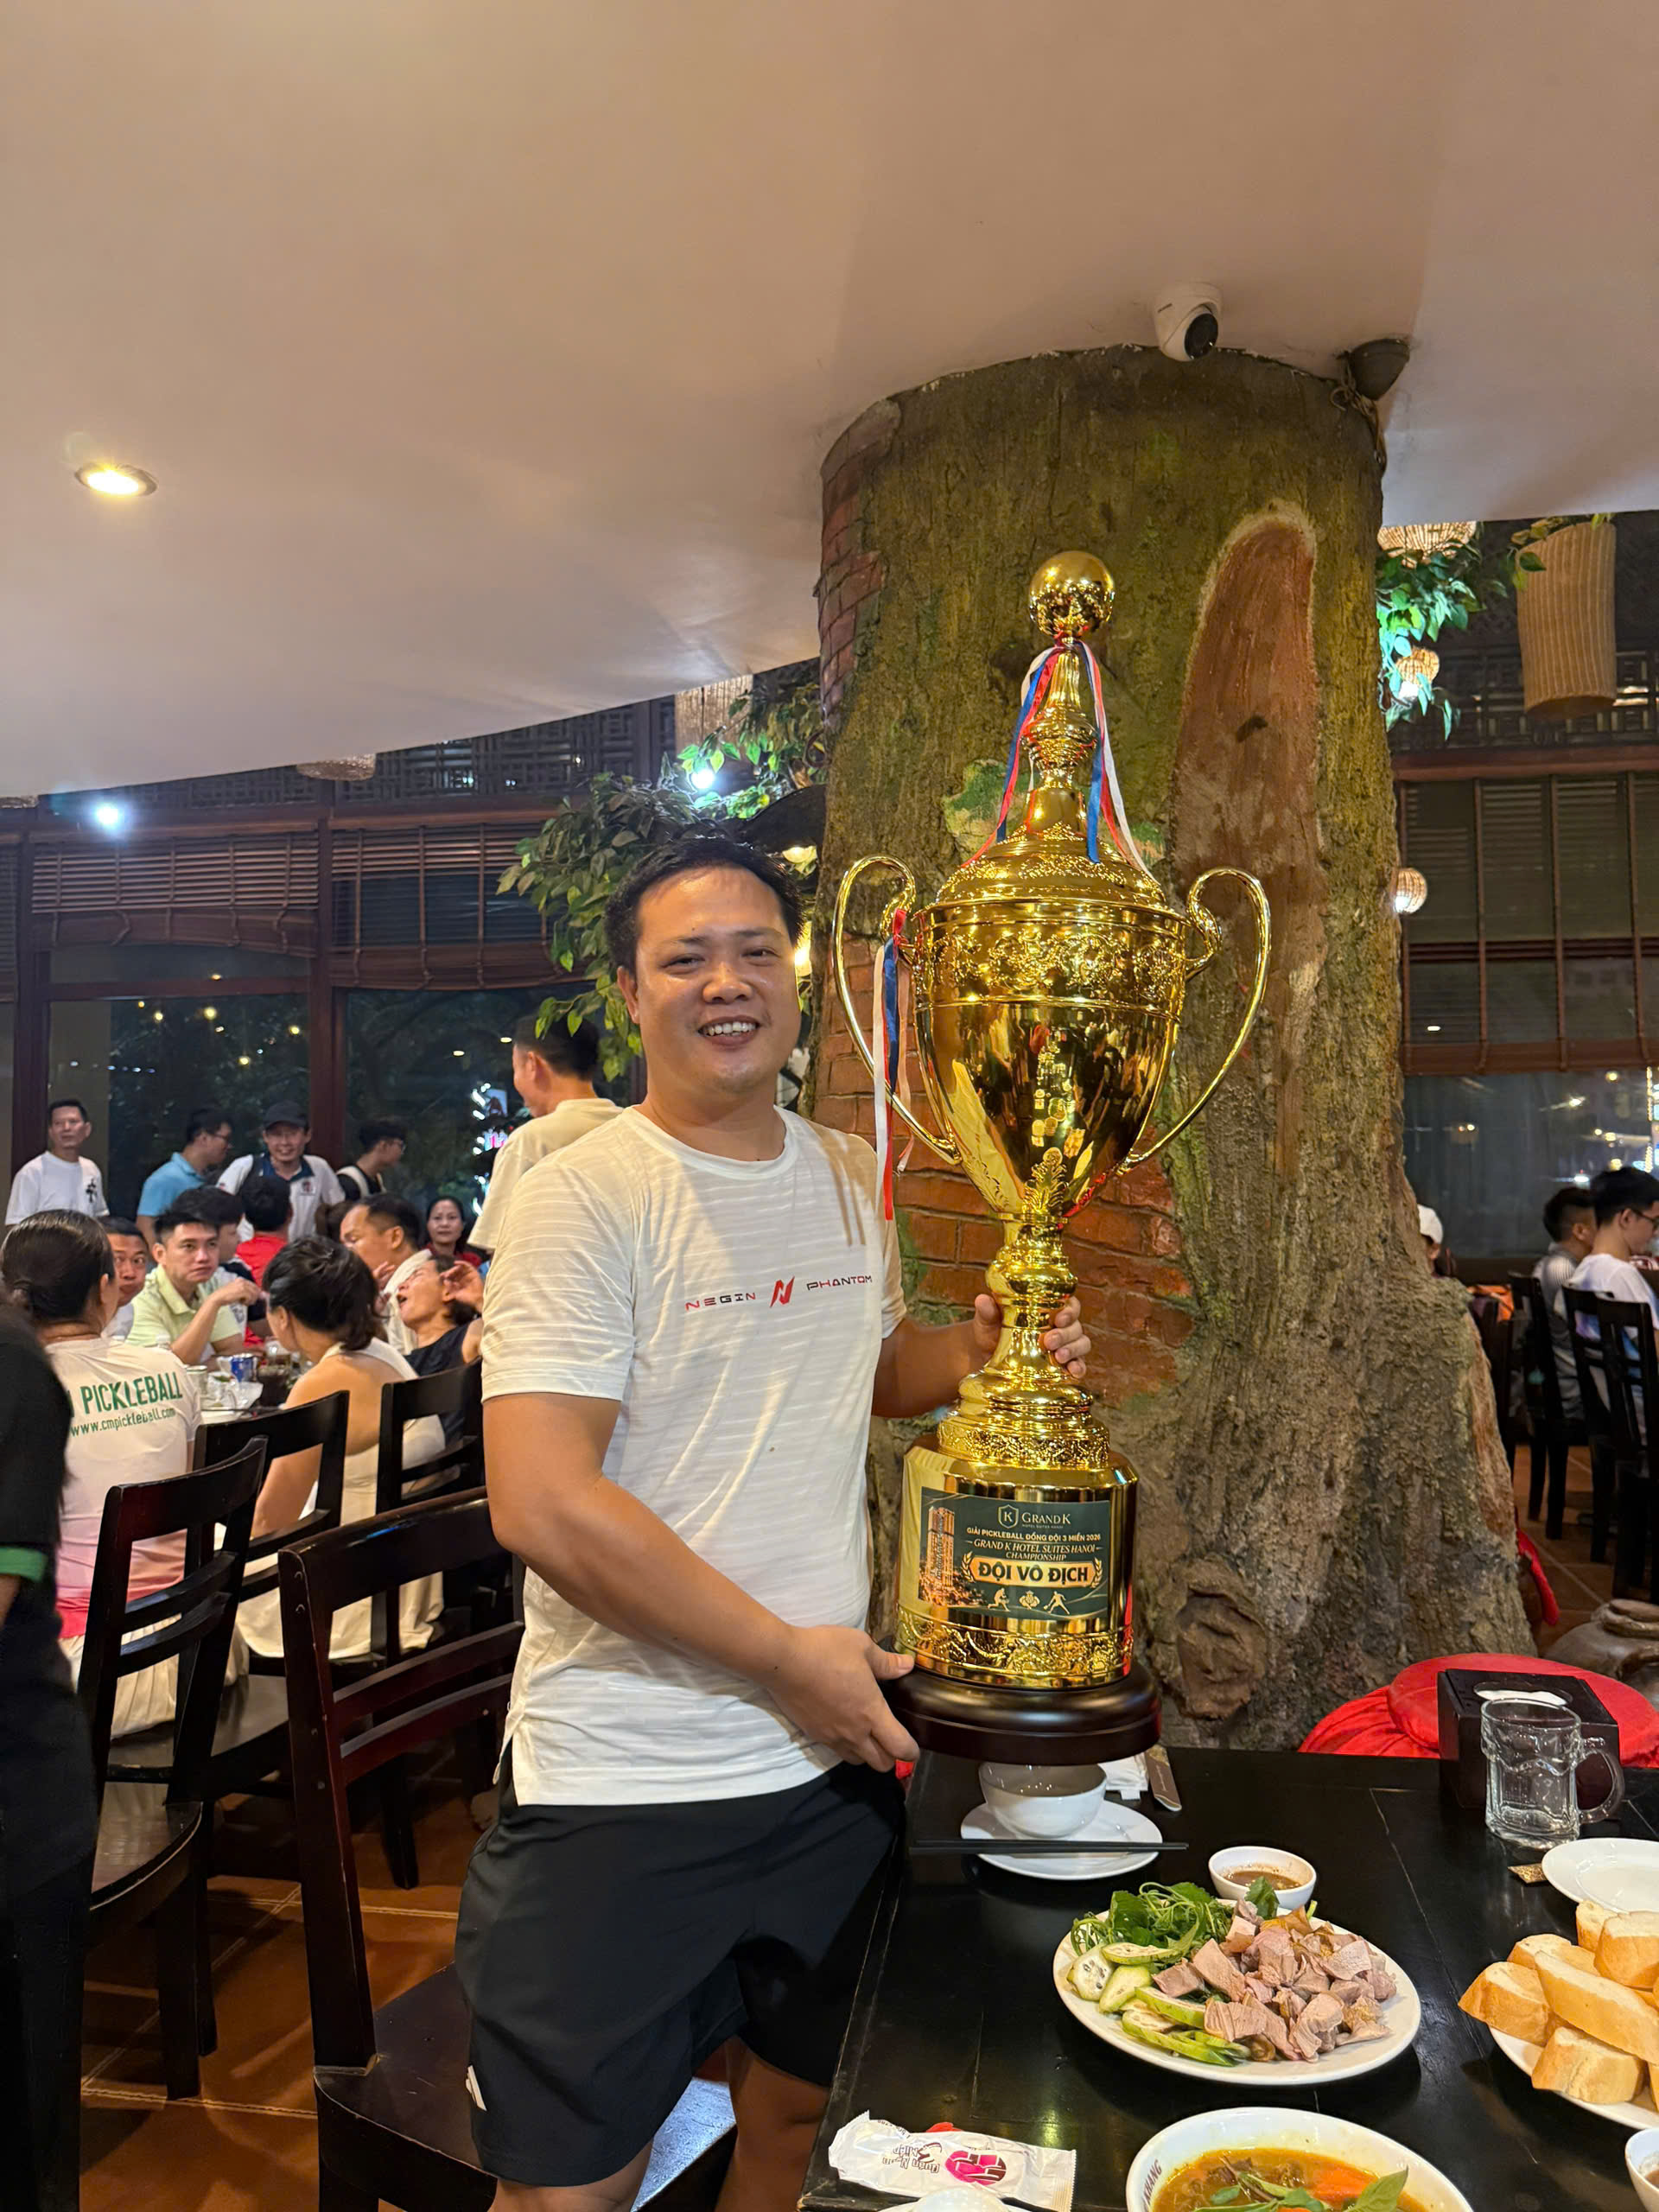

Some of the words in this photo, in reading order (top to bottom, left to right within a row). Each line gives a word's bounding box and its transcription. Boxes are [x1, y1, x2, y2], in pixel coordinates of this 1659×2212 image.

[684, 1292, 756, 1311] NEGIN
[806, 1274, 872, 1290] PHANTOM
[79, 1370, 183, 1414] PICKLEBALL
[982, 1529, 1024, 1540] PICKLEBALL
[974, 1538, 1004, 1549] GRAND
[1012, 1542, 1041, 1553] HOTEL
[1042, 1544, 1071, 1554] SUITES
[1071, 1543, 1096, 1554] HANOI
[1006, 1551, 1067, 1561] CHAMPIONSHIP
[978, 1560, 1012, 1582] ĐỘI
[1016, 1564, 1044, 1582] VÔ
[1048, 1567, 1088, 1586] ĐỊCH
